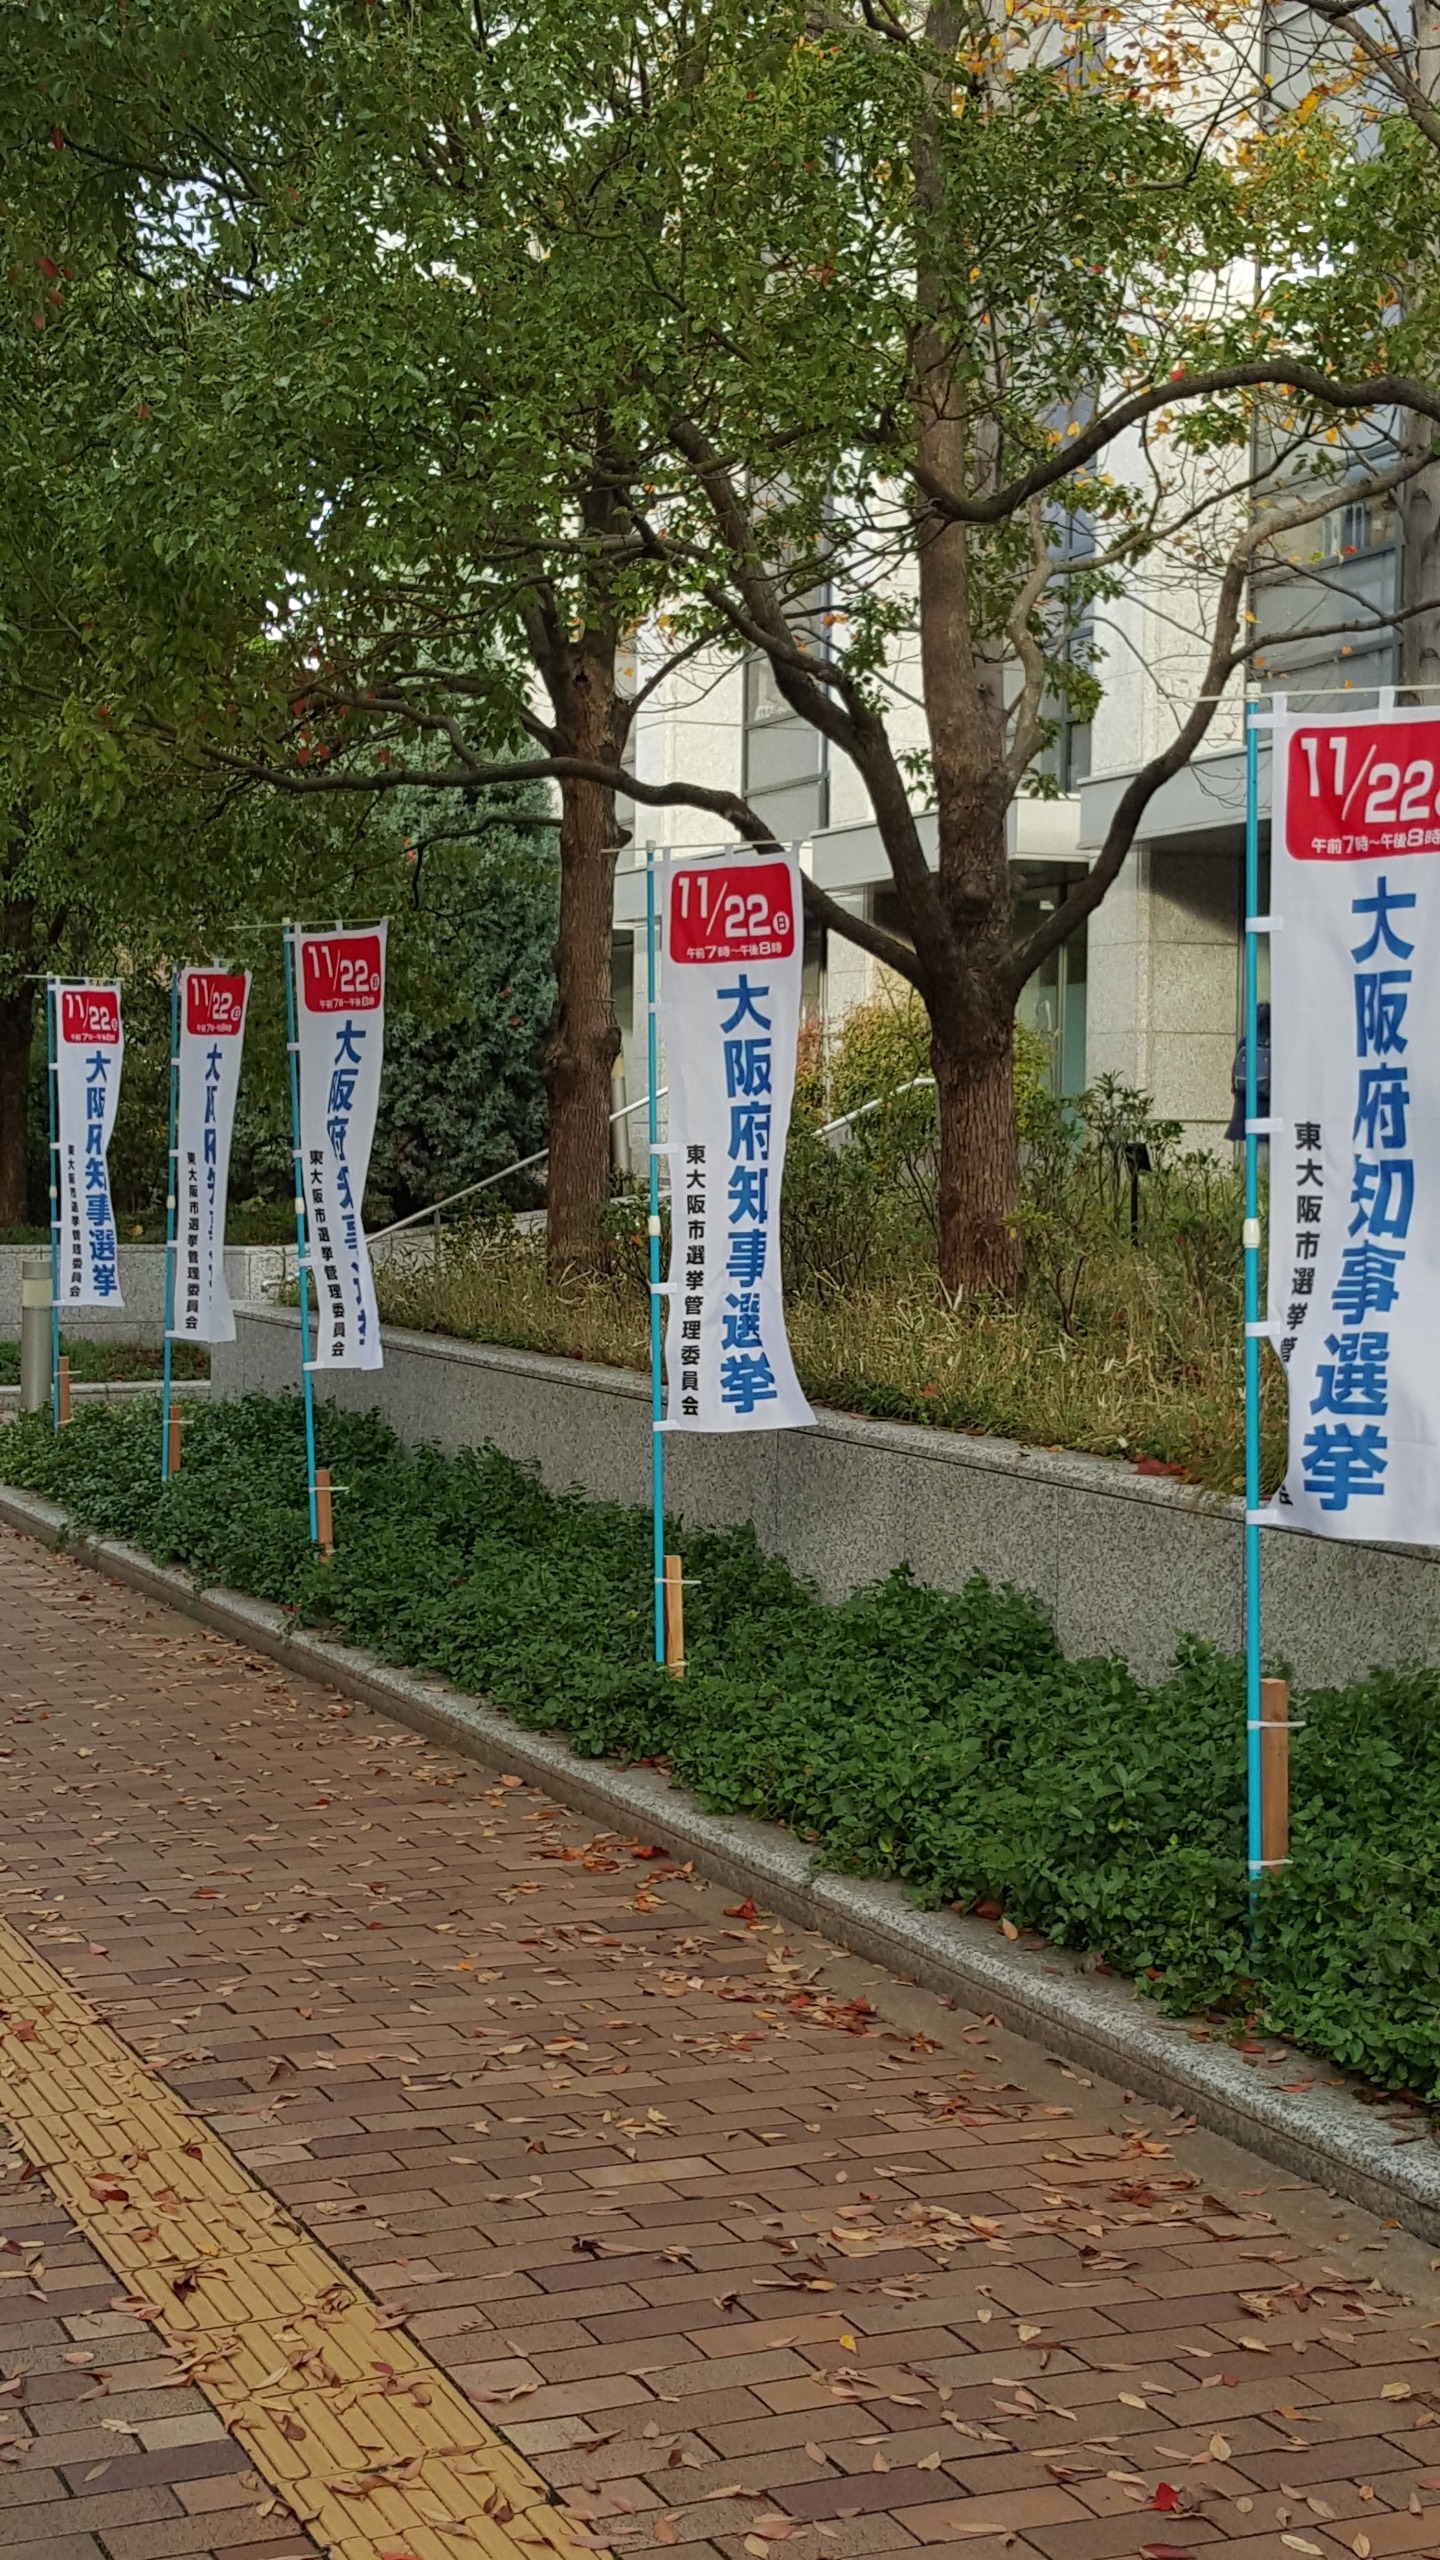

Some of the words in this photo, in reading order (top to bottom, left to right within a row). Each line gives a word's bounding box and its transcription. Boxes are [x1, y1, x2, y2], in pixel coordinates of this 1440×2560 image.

[1301, 736, 1434, 824] 11/22
[678, 876, 771, 938] 11/22
[310, 1150, 345, 1357] 東大阪市選挙管理委員会
[681, 1144, 706, 1416] 東大阪市選挙管理委員会
